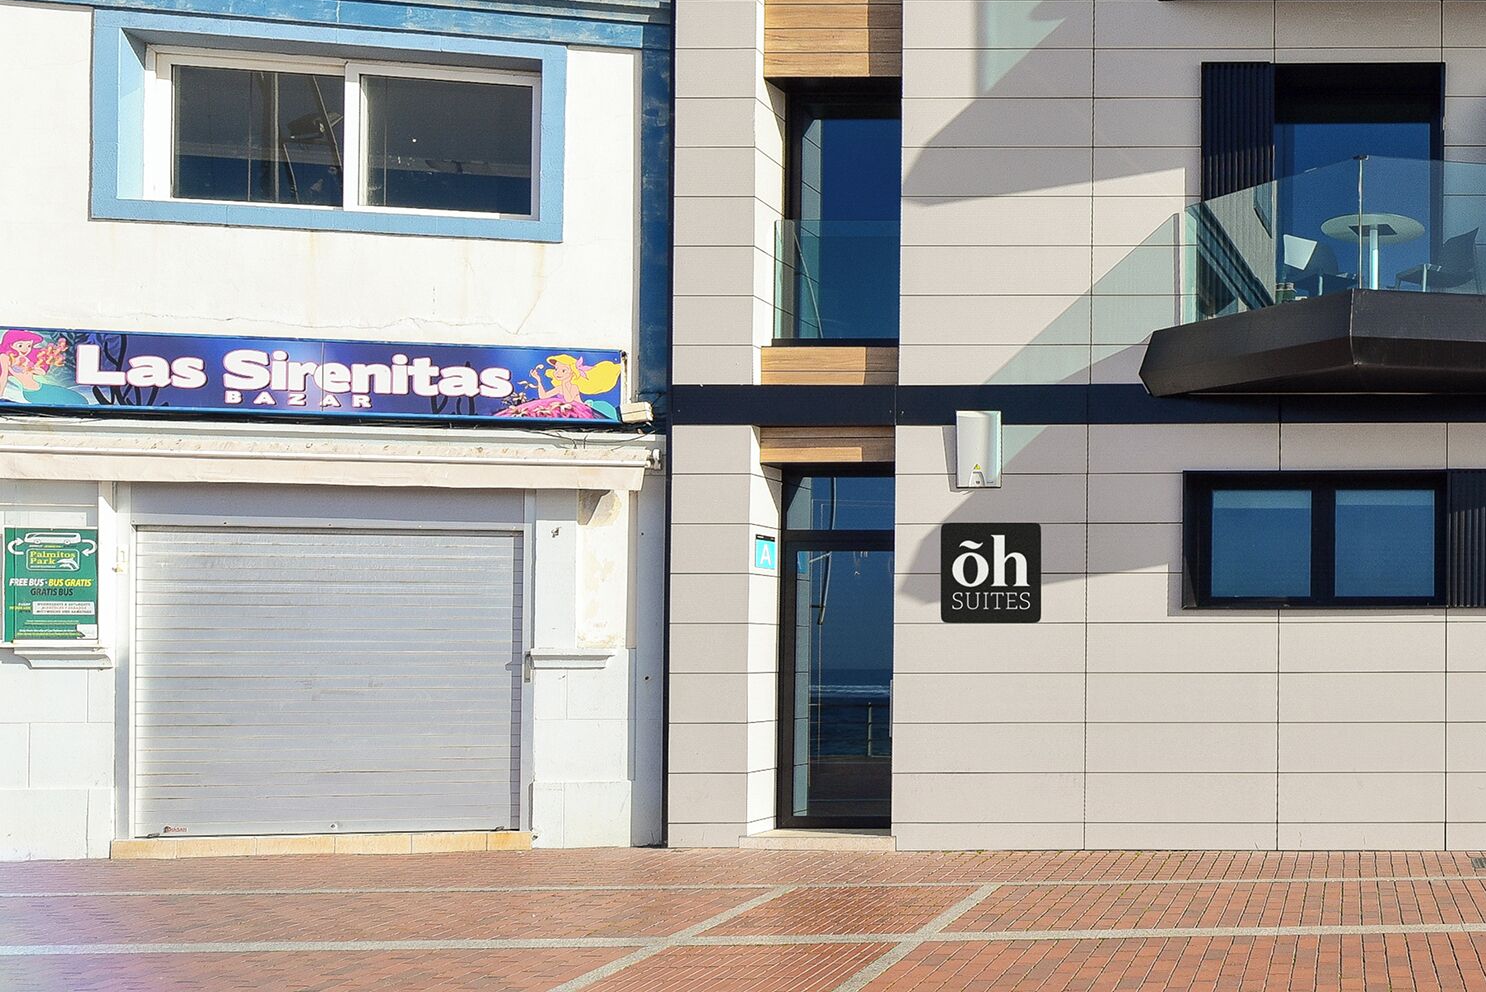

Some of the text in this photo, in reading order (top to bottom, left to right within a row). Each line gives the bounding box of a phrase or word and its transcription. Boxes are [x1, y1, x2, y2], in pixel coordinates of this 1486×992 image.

[76, 343, 515, 398] Las Sirenitas
[225, 390, 372, 408] BAZAR
[30, 550, 76, 558] Palmitos
[760, 544, 772, 566] A
[951, 534, 1030, 588] õh
[9, 578, 28, 586] FREE
[48, 578, 64, 587] BUS
[65, 578, 92, 587] GRATIS
[30, 588, 73, 596] GRATIS BUS
[951, 591, 1032, 611] SUITES
